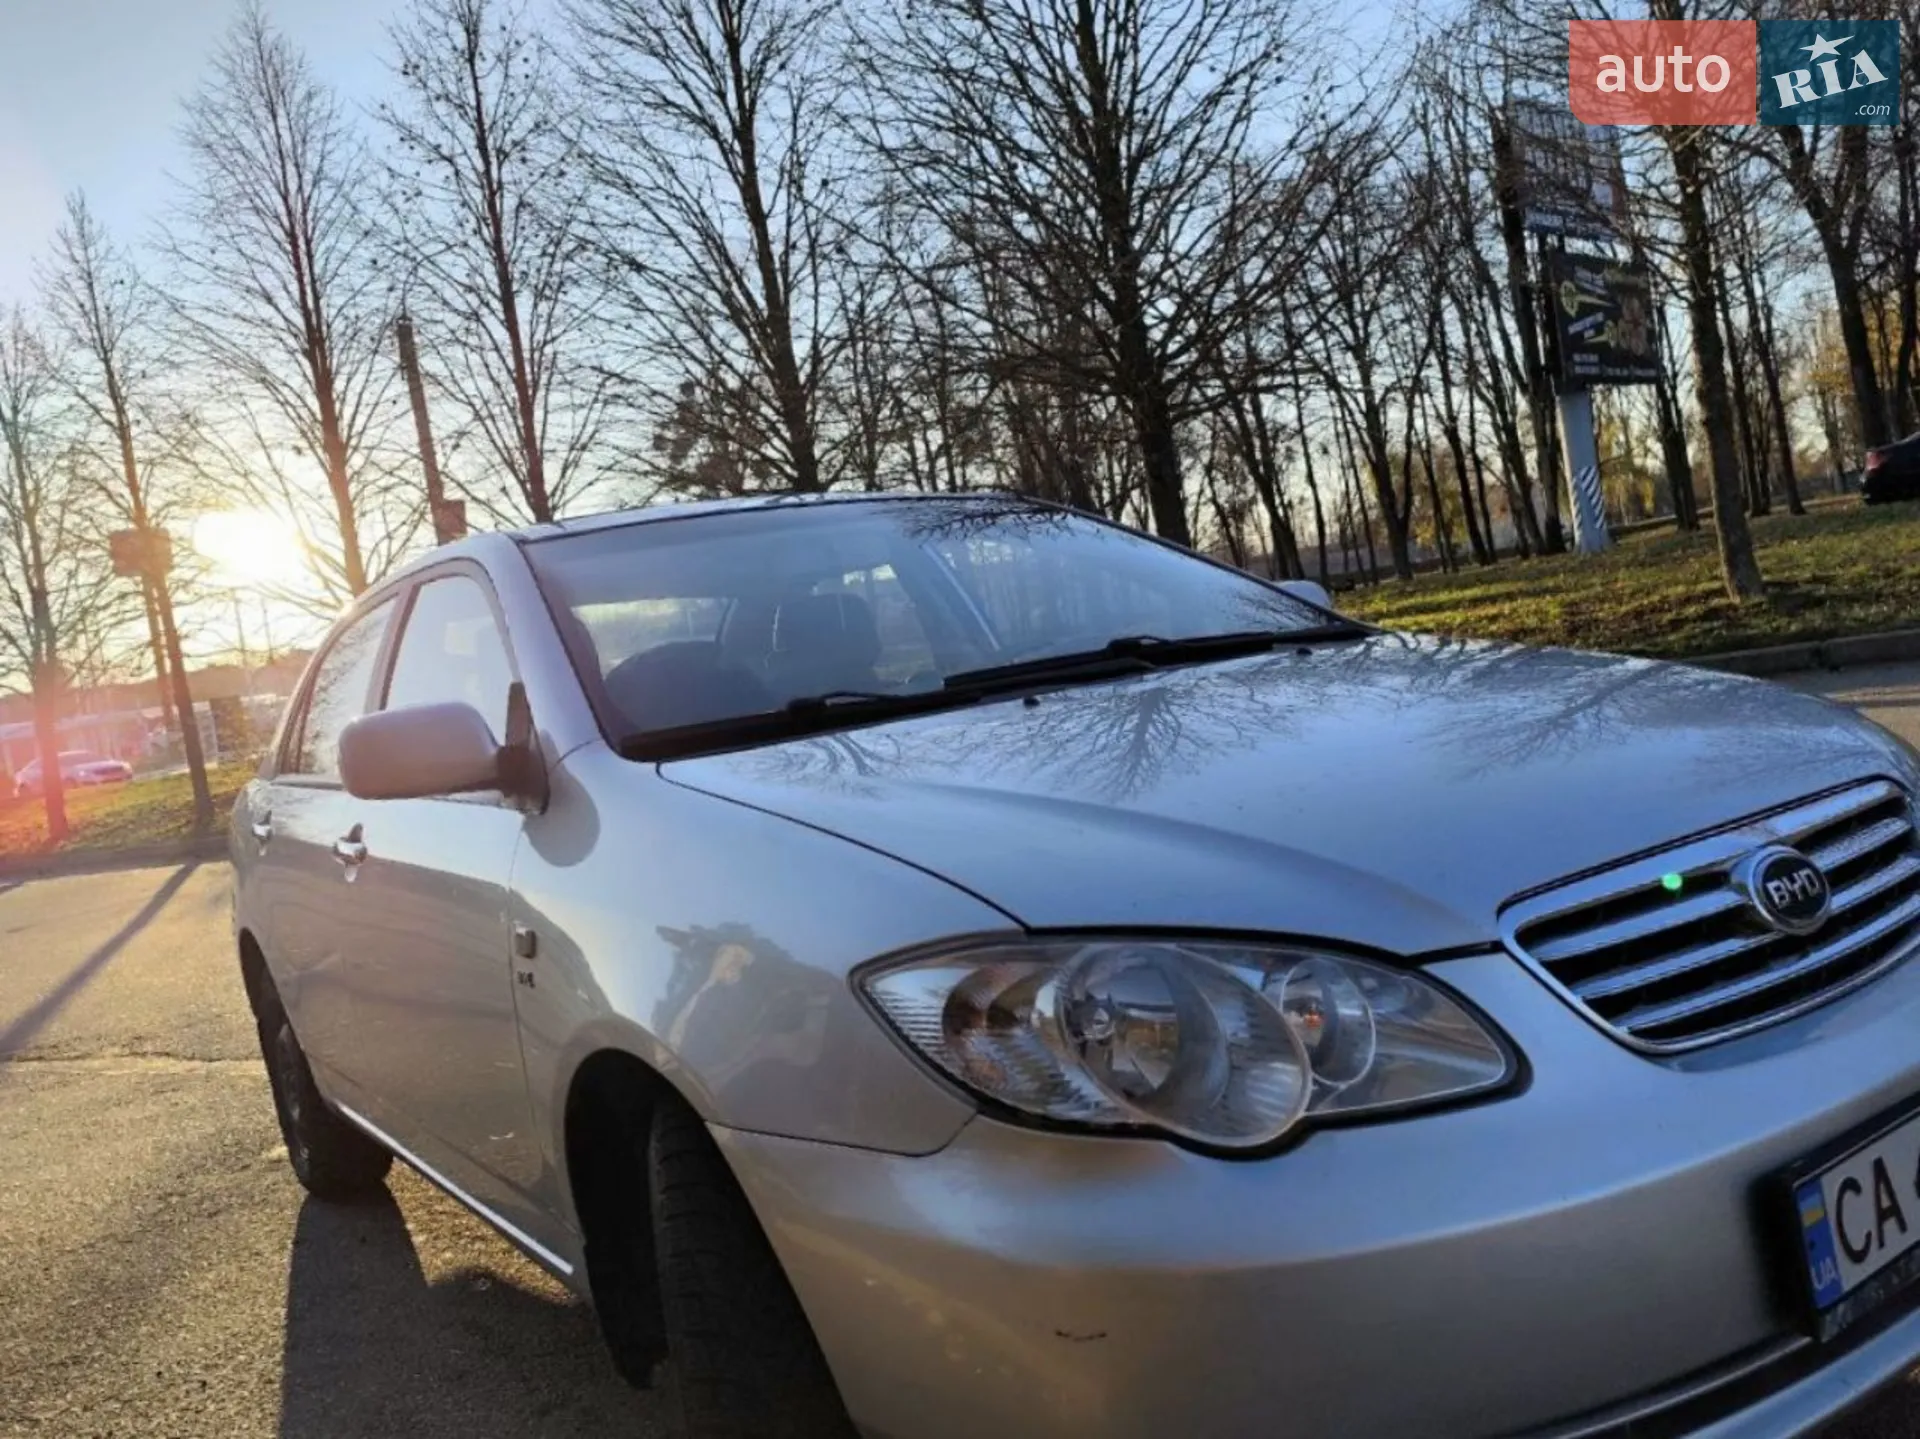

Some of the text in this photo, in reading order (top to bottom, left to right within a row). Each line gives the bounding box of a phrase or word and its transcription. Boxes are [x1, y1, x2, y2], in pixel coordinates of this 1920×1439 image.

[1766, 867, 1820, 909] BYD
[1836, 1155, 1908, 1264] CA
[1810, 1256, 1838, 1290] UA
